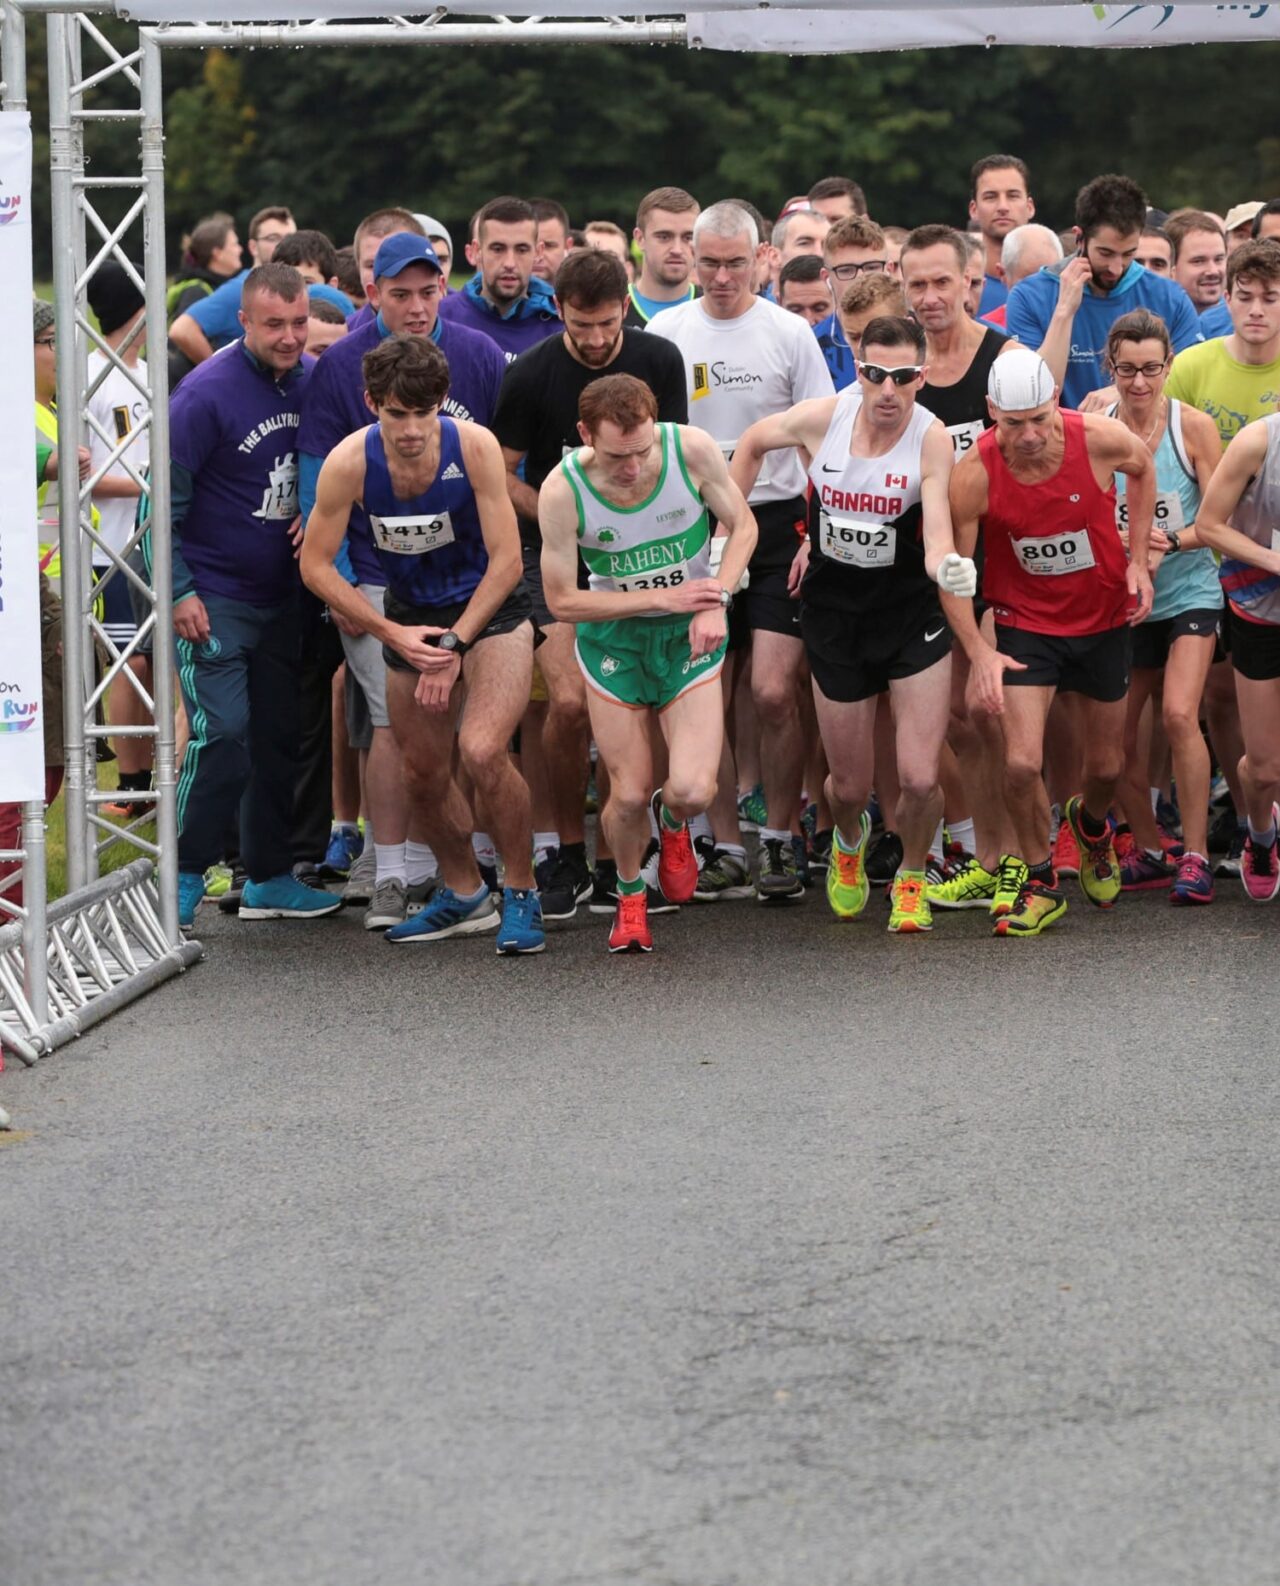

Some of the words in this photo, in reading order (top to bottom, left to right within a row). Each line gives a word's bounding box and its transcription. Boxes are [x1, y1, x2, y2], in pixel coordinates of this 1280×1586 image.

[710, 361, 763, 387] Simon
[238, 430, 262, 454] THE
[821, 484, 903, 516] CANADA
[1118, 500, 1169, 522] 86
[378, 520, 444, 537] 1419
[825, 522, 889, 548] 1602
[609, 538, 688, 574] RAHENY
[1022, 540, 1077, 560] 800
[4, 701, 39, 719] RUN
